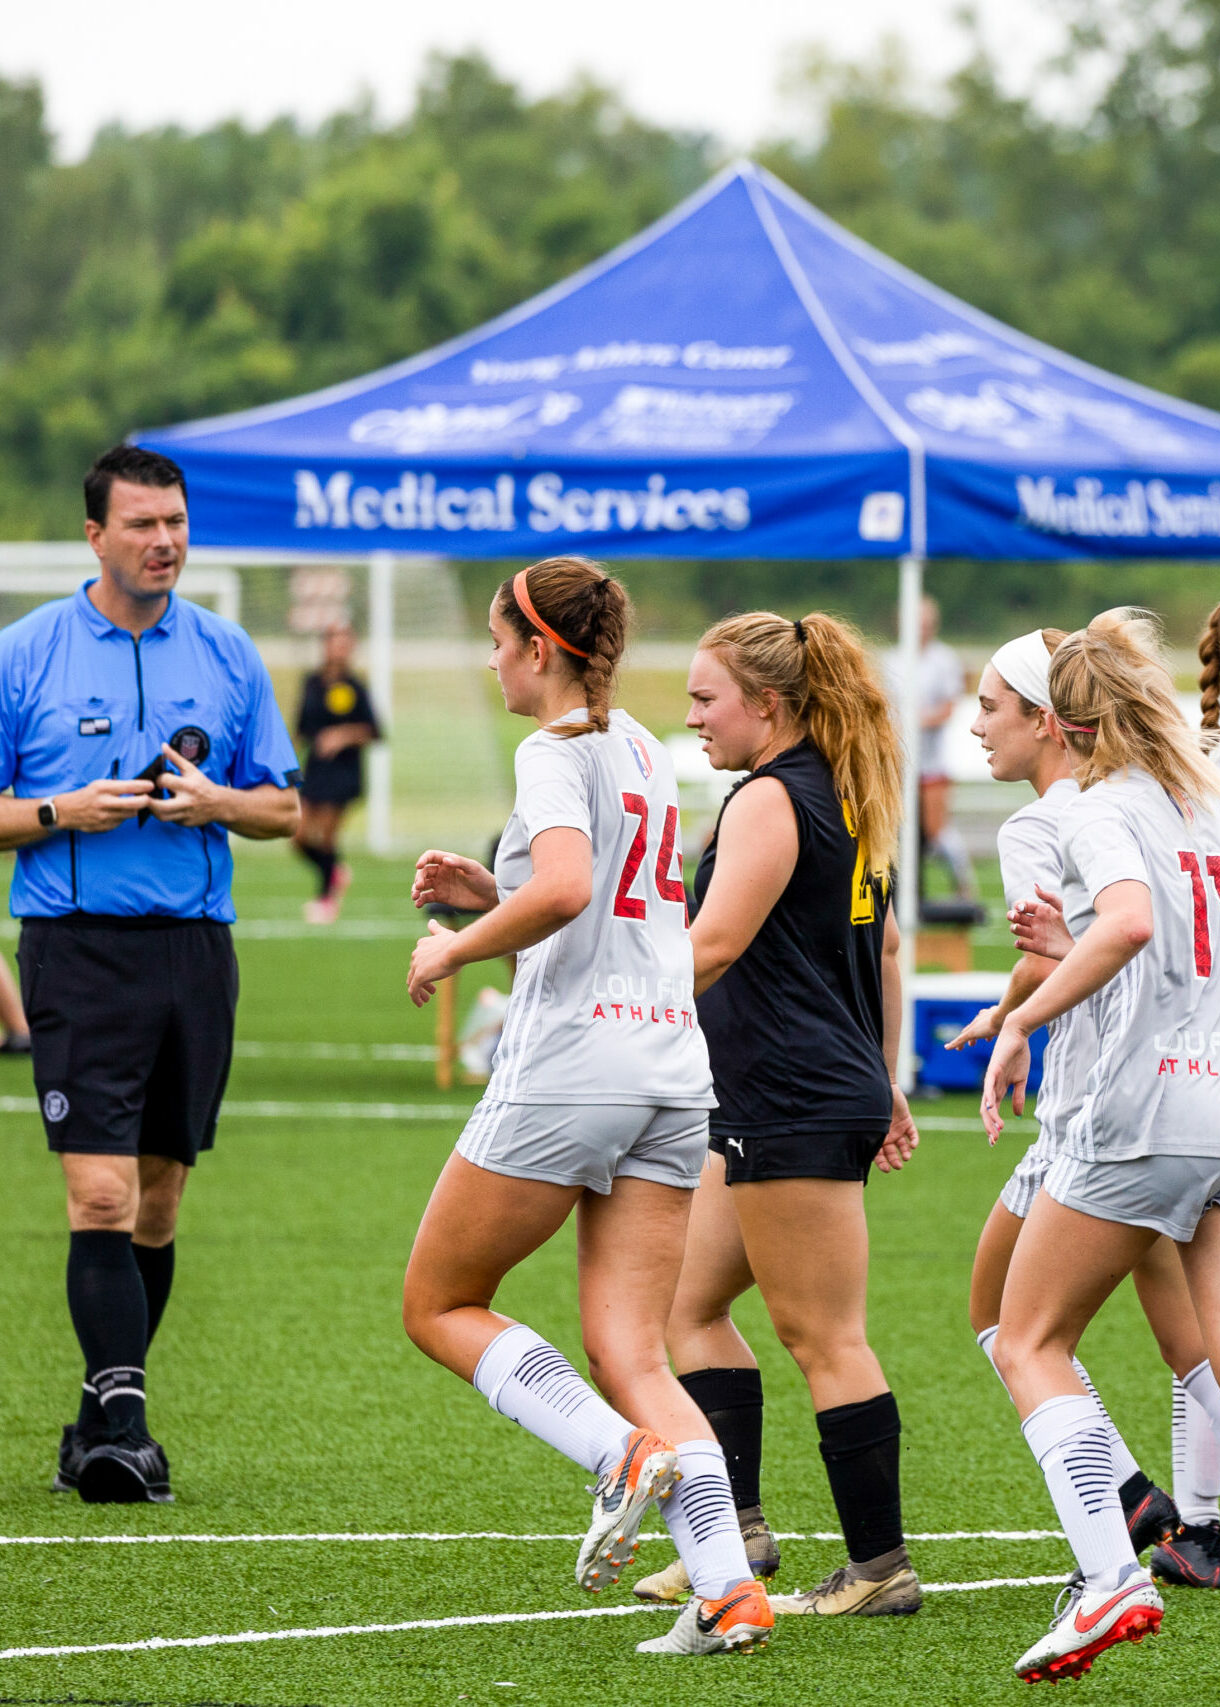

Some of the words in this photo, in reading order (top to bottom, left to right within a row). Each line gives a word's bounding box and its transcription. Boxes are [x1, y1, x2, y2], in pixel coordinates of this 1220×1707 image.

[294, 469, 516, 531] Medical
[527, 472, 751, 532] Services
[610, 791, 690, 931] 24
[591, 972, 647, 1000] LOU
